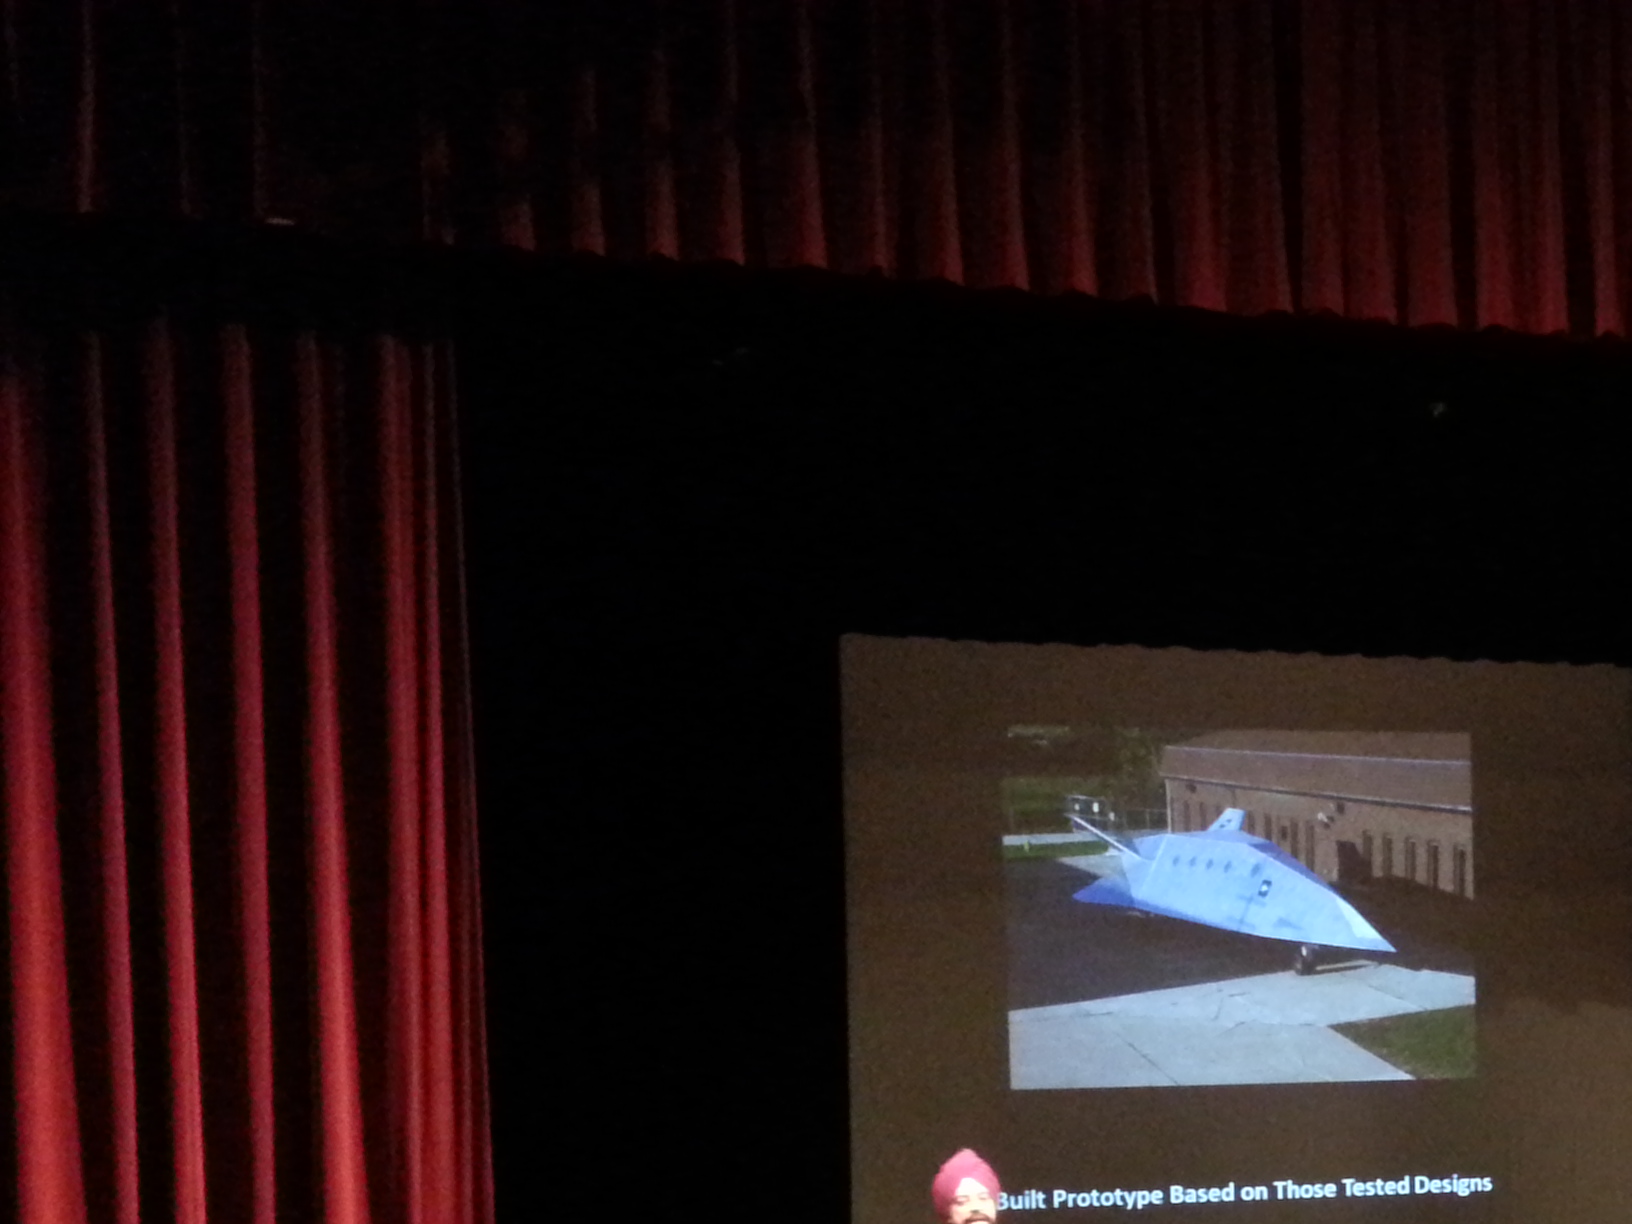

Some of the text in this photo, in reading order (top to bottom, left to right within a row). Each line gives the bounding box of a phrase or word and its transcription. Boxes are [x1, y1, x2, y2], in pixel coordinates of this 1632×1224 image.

[997, 1174, 1493, 1210] Built Prototype Based on Those Tested Designs
